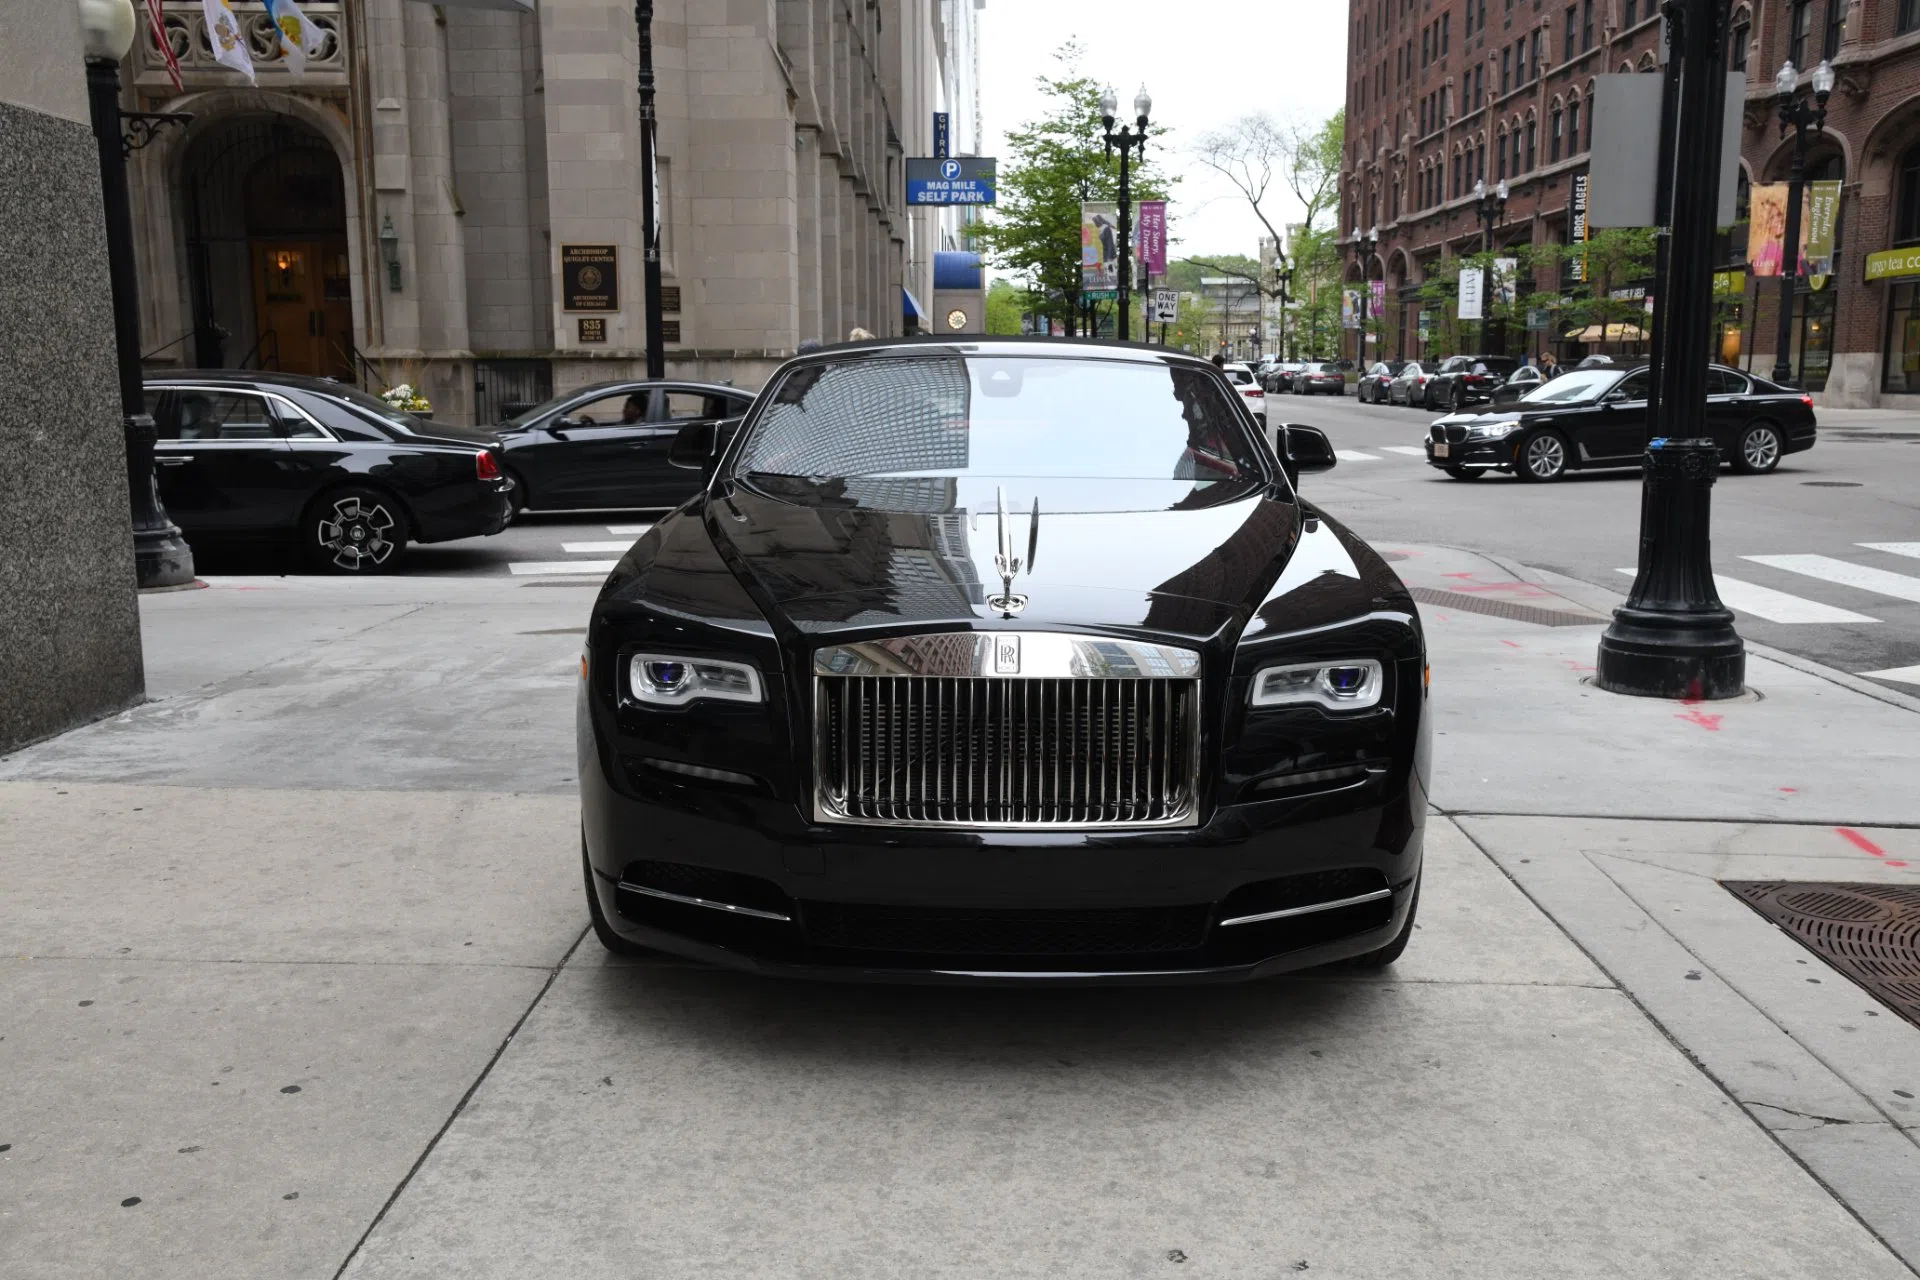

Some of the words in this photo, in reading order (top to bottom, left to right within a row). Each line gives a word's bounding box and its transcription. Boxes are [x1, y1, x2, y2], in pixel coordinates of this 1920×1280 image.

[946, 162, 957, 177] P
[927, 181, 950, 190] MAG
[951, 181, 976, 190] MILE
[918, 191, 948, 202] SELF
[951, 191, 985, 202] PARK
[1575, 175, 1587, 210] BAGELS
[1141, 213, 1151, 226] My
[1152, 214, 1161, 229] Her
[1811, 196, 1823, 244] Englewood
[1821, 196, 1834, 237] Everyday
[1889, 257, 1903, 270] tea
[1091, 292, 1110, 300] RUSH
[1158, 293, 1176, 301] ONE
[1157, 301, 1176, 310] WAY
[583, 320, 601, 330] 835
